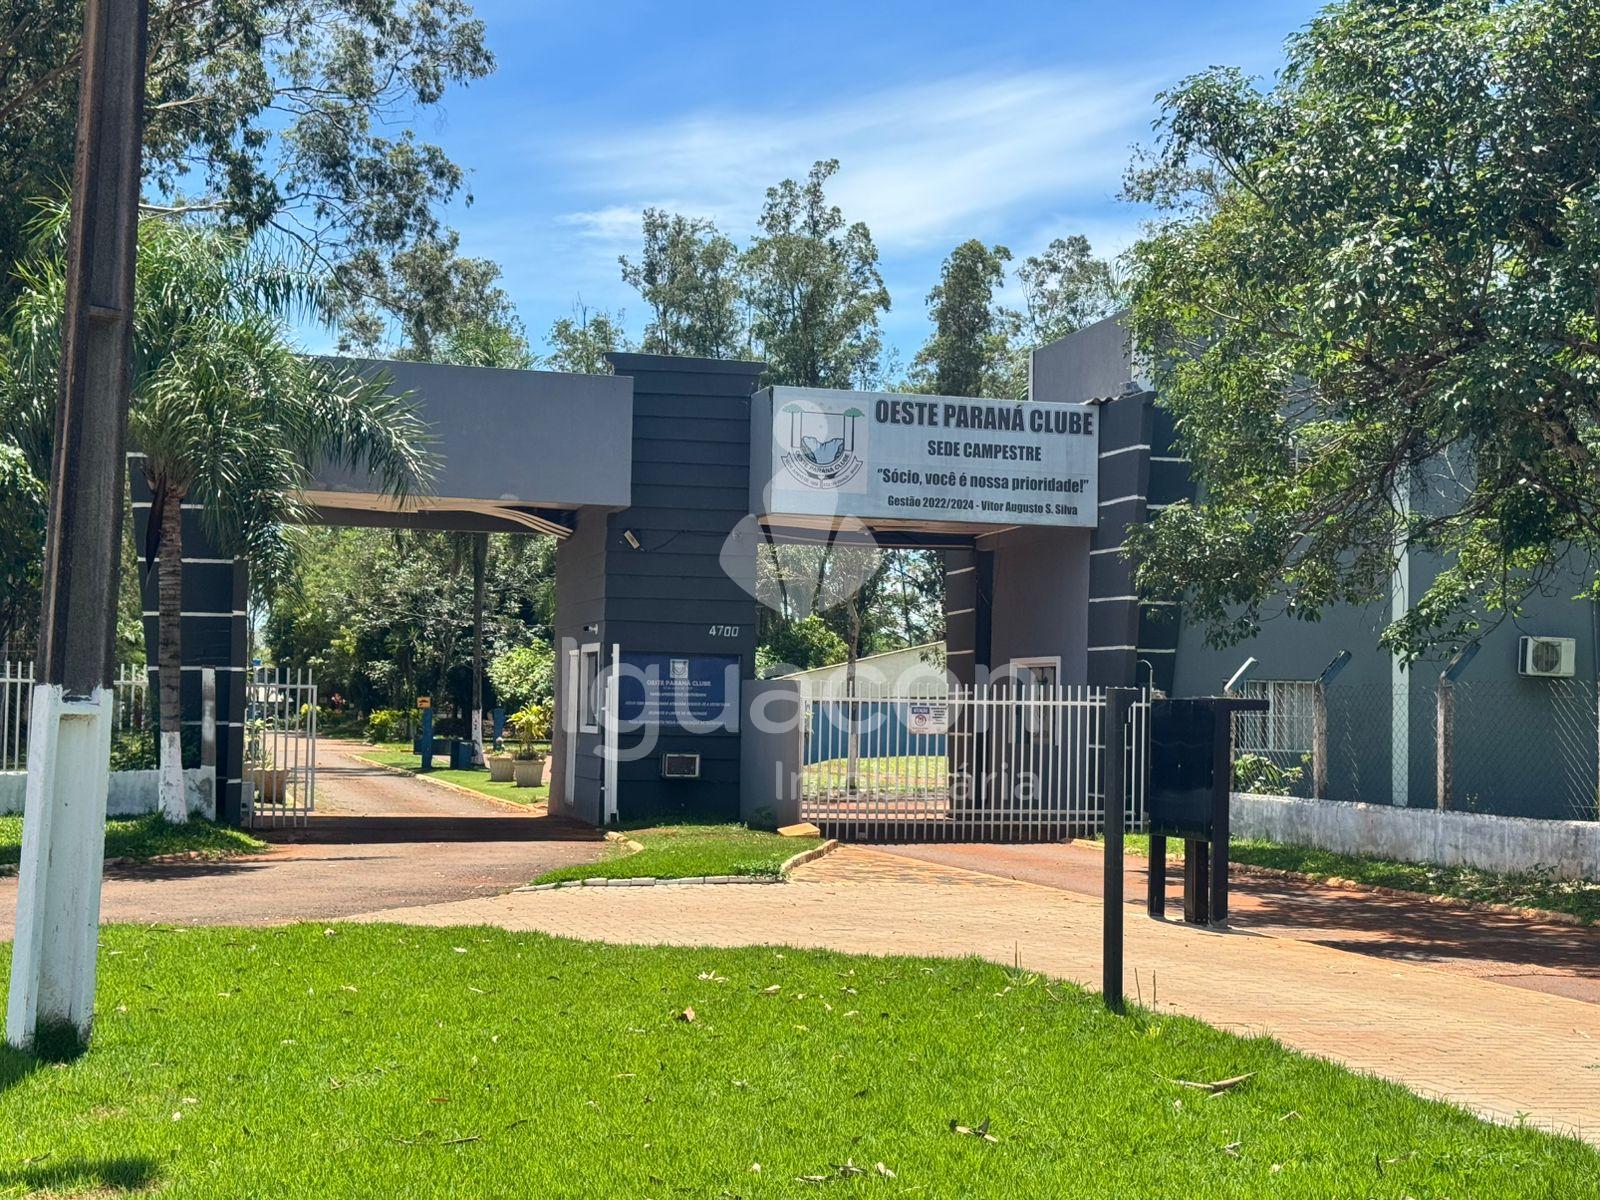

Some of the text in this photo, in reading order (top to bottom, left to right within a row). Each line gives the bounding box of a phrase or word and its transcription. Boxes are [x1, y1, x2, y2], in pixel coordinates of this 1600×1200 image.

[875, 399, 1093, 435] OESTE PARANÁ CLUBE
[927, 440, 1042, 462] SEDE CAMPESTRE
[925, 472, 956, 487] você
[959, 472, 967, 487] é
[970, 475, 1009, 489] nossa
[887, 495, 921, 507] Gestão
[922, 497, 974, 510] 2022/2024
[981, 500, 1004, 511] Vitor
[1005, 501, 1043, 514] Augusto
[1045, 503, 1053, 514] S.
[1055, 504, 1078, 515] Silva
[708, 625, 739, 637] 4700
